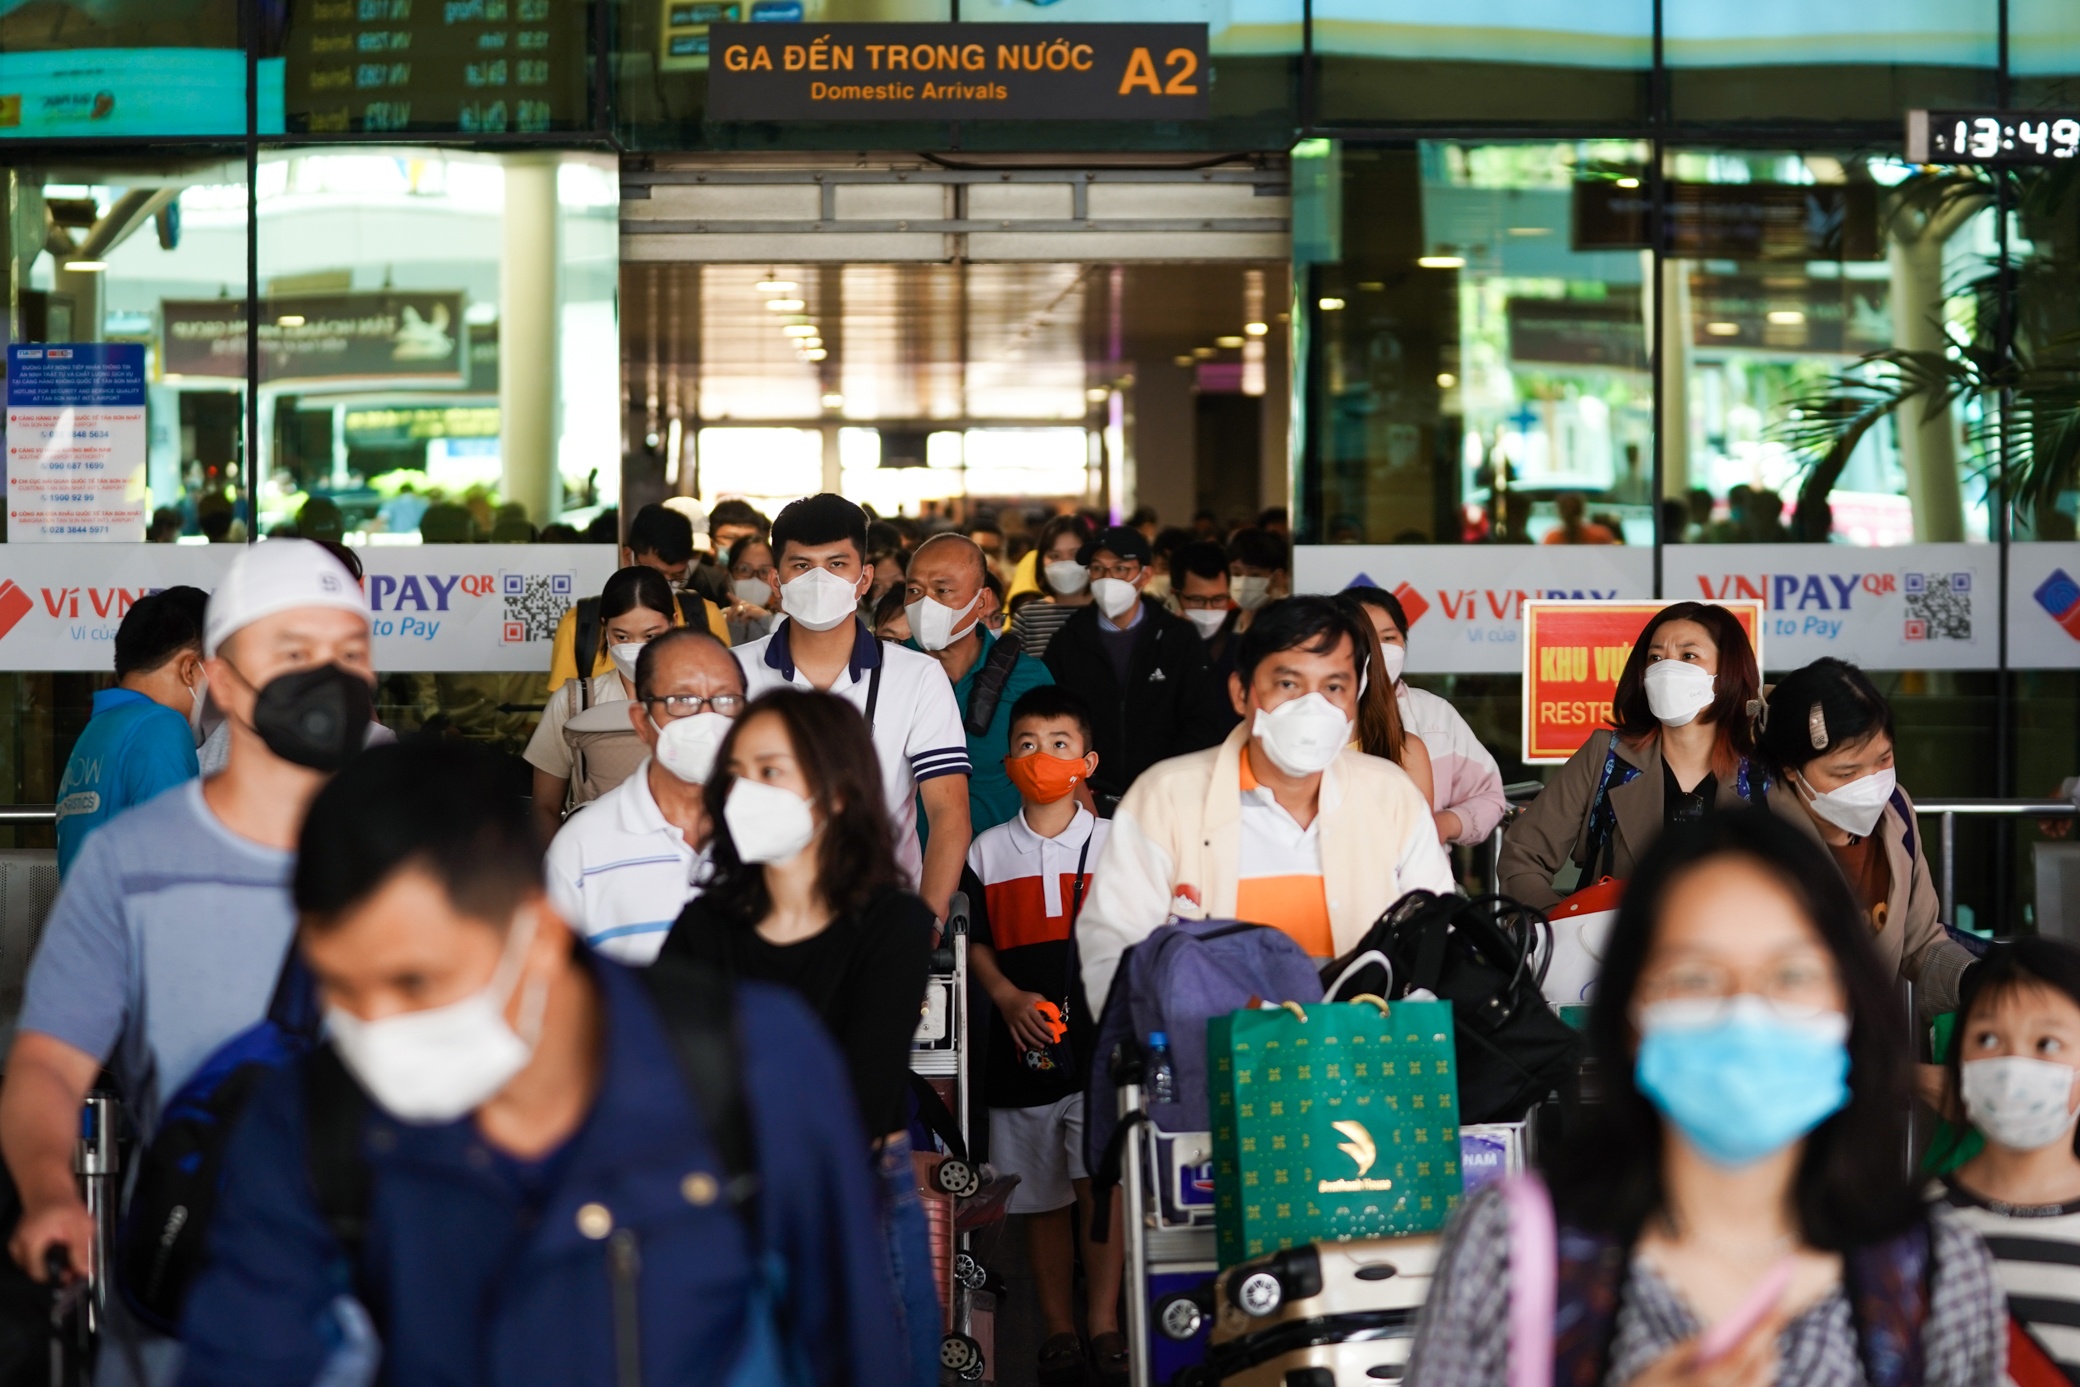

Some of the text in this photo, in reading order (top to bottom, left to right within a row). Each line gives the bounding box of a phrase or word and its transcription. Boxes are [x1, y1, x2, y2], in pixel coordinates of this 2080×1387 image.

[724, 34, 1094, 71] GA ĐẾN TRONG NƯỚC
[1119, 47, 1198, 95] A2
[811, 82, 1008, 100] Domestic Arrivals
[1953, 118, 2080, 158] 13:49
[49, 526, 109, 534] 028 3844 5971
[41, 587, 81, 618] Ví
[1437, 590, 1477, 620] Ví
[372, 617, 440, 641] to Pay
[1775, 616, 1843, 640] to Pay
[1540, 641, 1635, 688] KHU VỰ
[1540, 701, 1624, 724] RESTR
